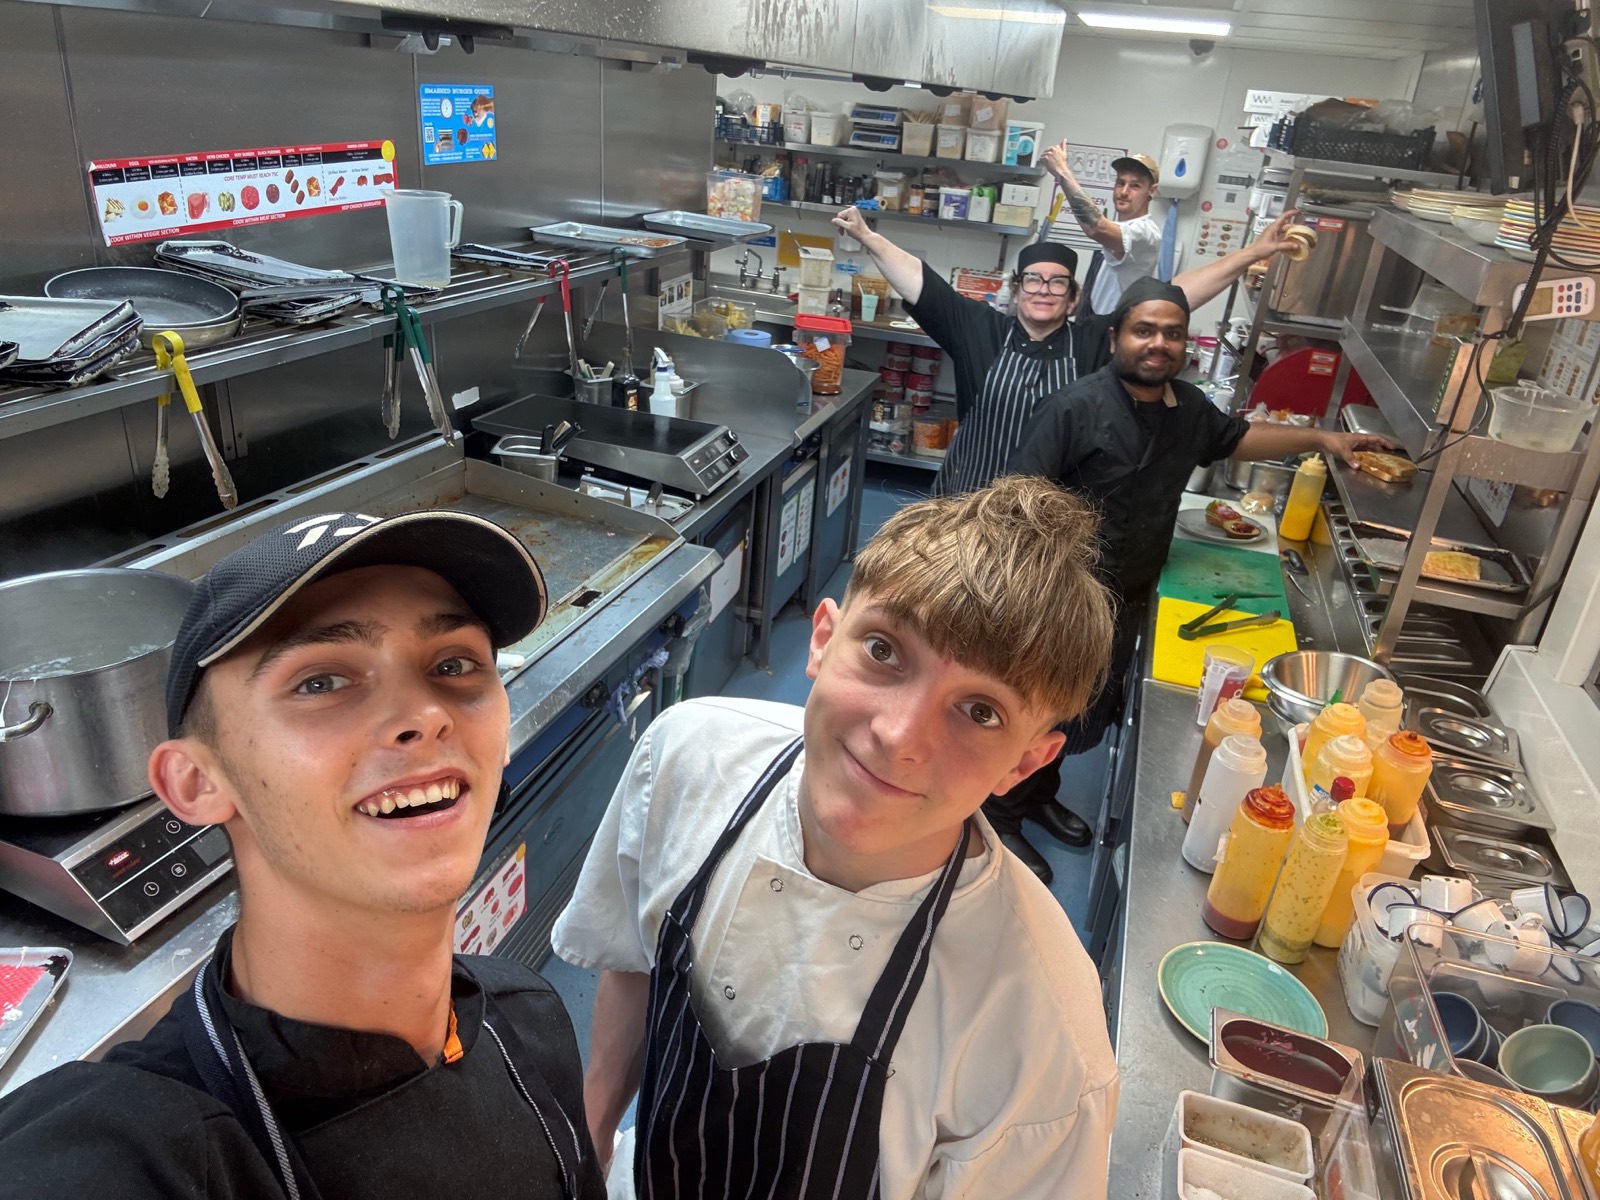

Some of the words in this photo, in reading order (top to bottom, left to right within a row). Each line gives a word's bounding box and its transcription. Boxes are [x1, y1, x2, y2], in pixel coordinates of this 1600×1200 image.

[125, 233, 143, 242] WITHIN
[143, 231, 160, 239] VEGGIE
[160, 228, 180, 236] SECTION
